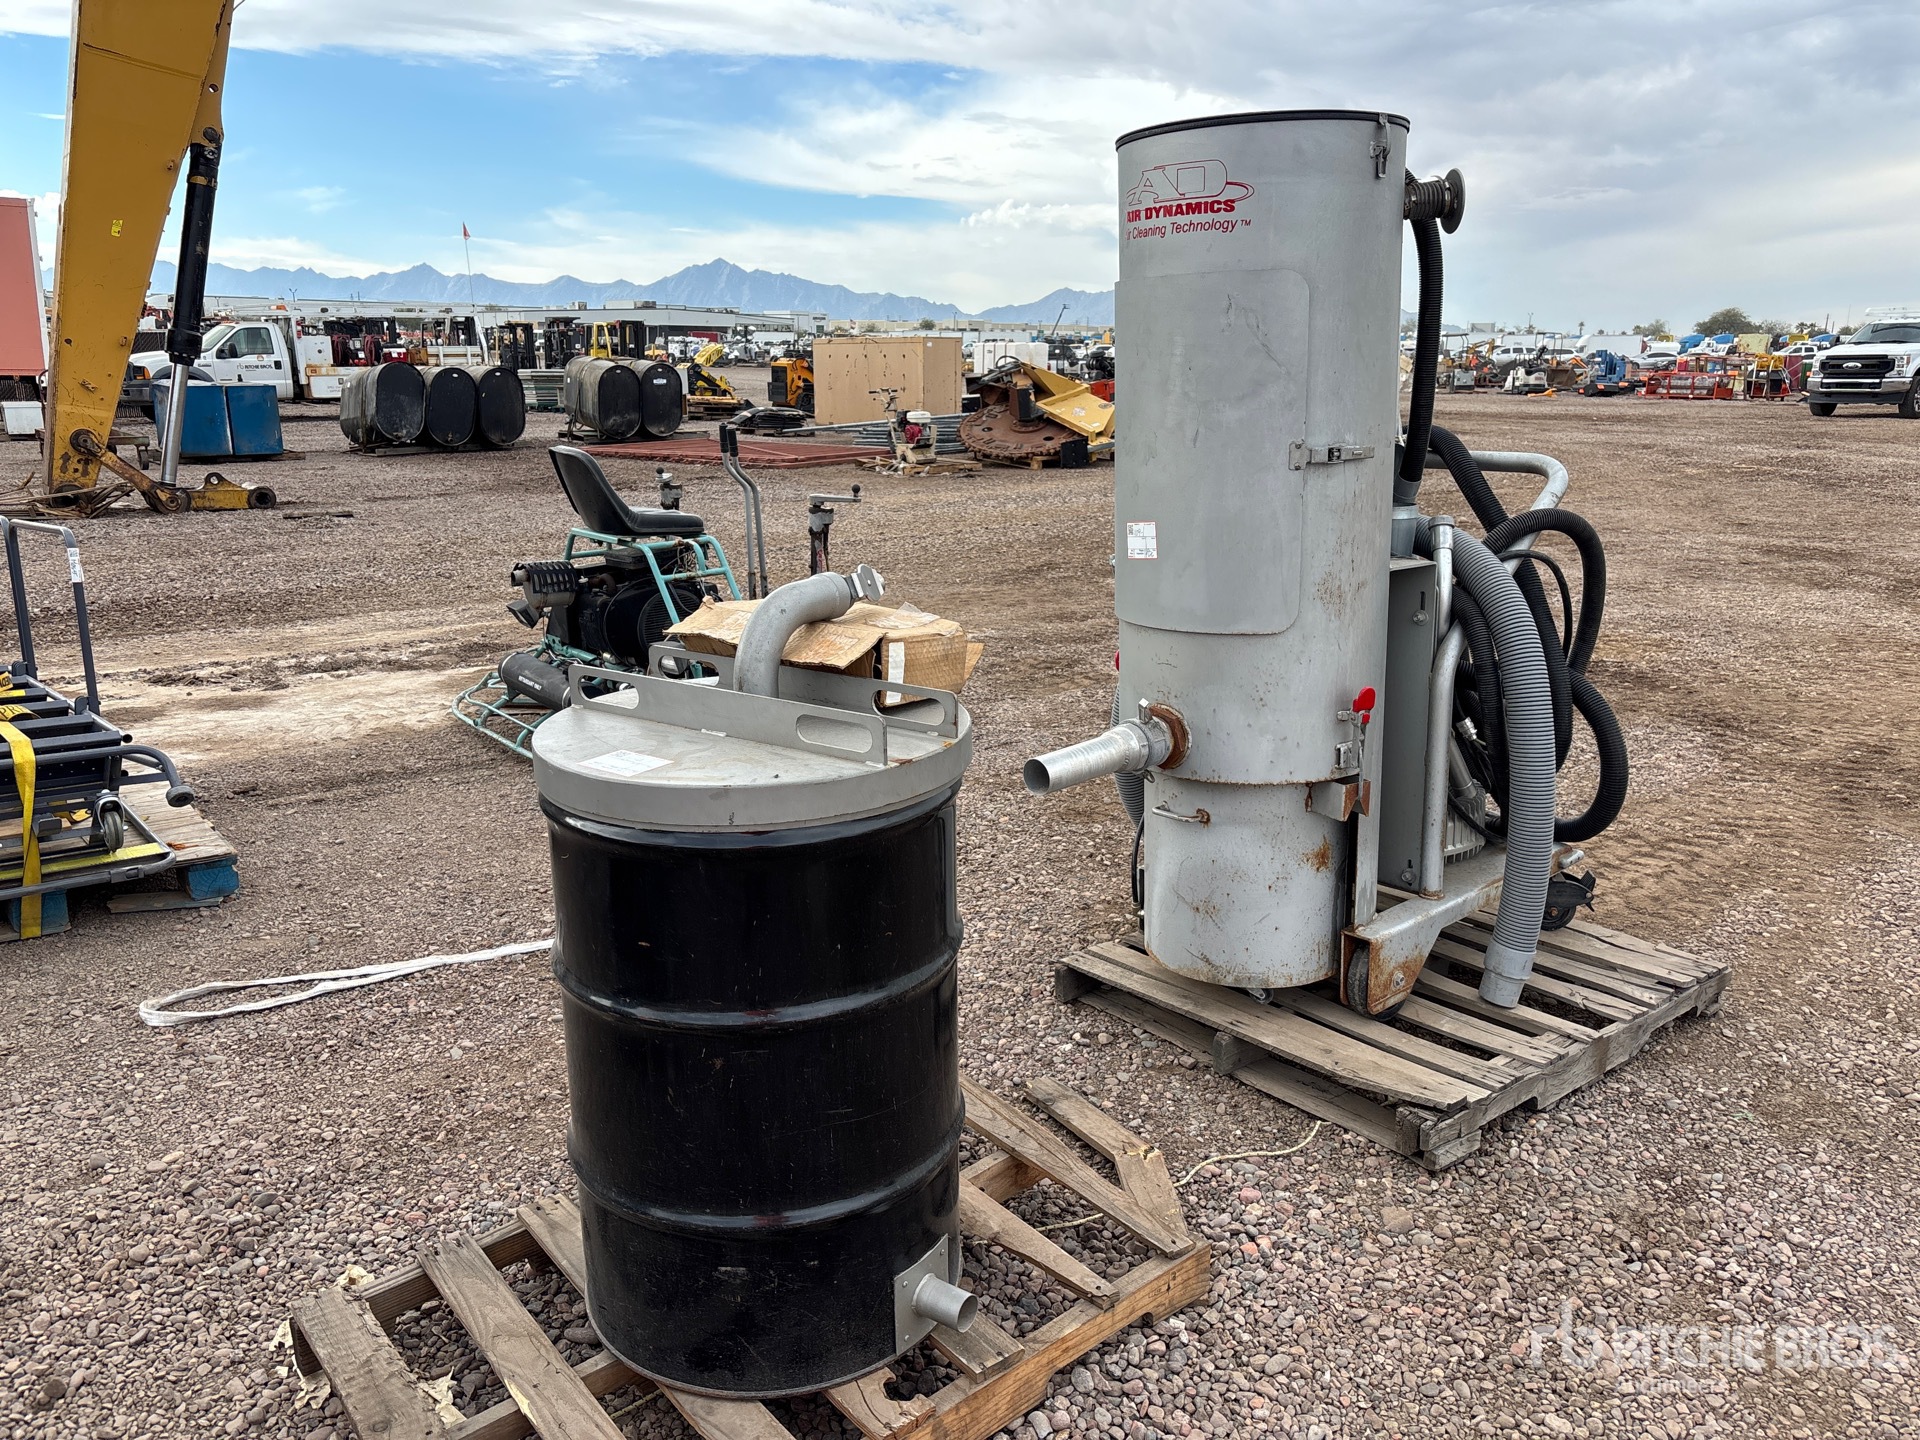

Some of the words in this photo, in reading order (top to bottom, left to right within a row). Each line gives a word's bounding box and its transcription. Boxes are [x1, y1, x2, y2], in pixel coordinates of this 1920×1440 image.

[1126, 210, 1141, 223] AIR
[1145, 199, 1236, 220] DYNAMICS
[1132, 223, 1166, 239] Cleaning
[1170, 218, 1238, 234] Technology
